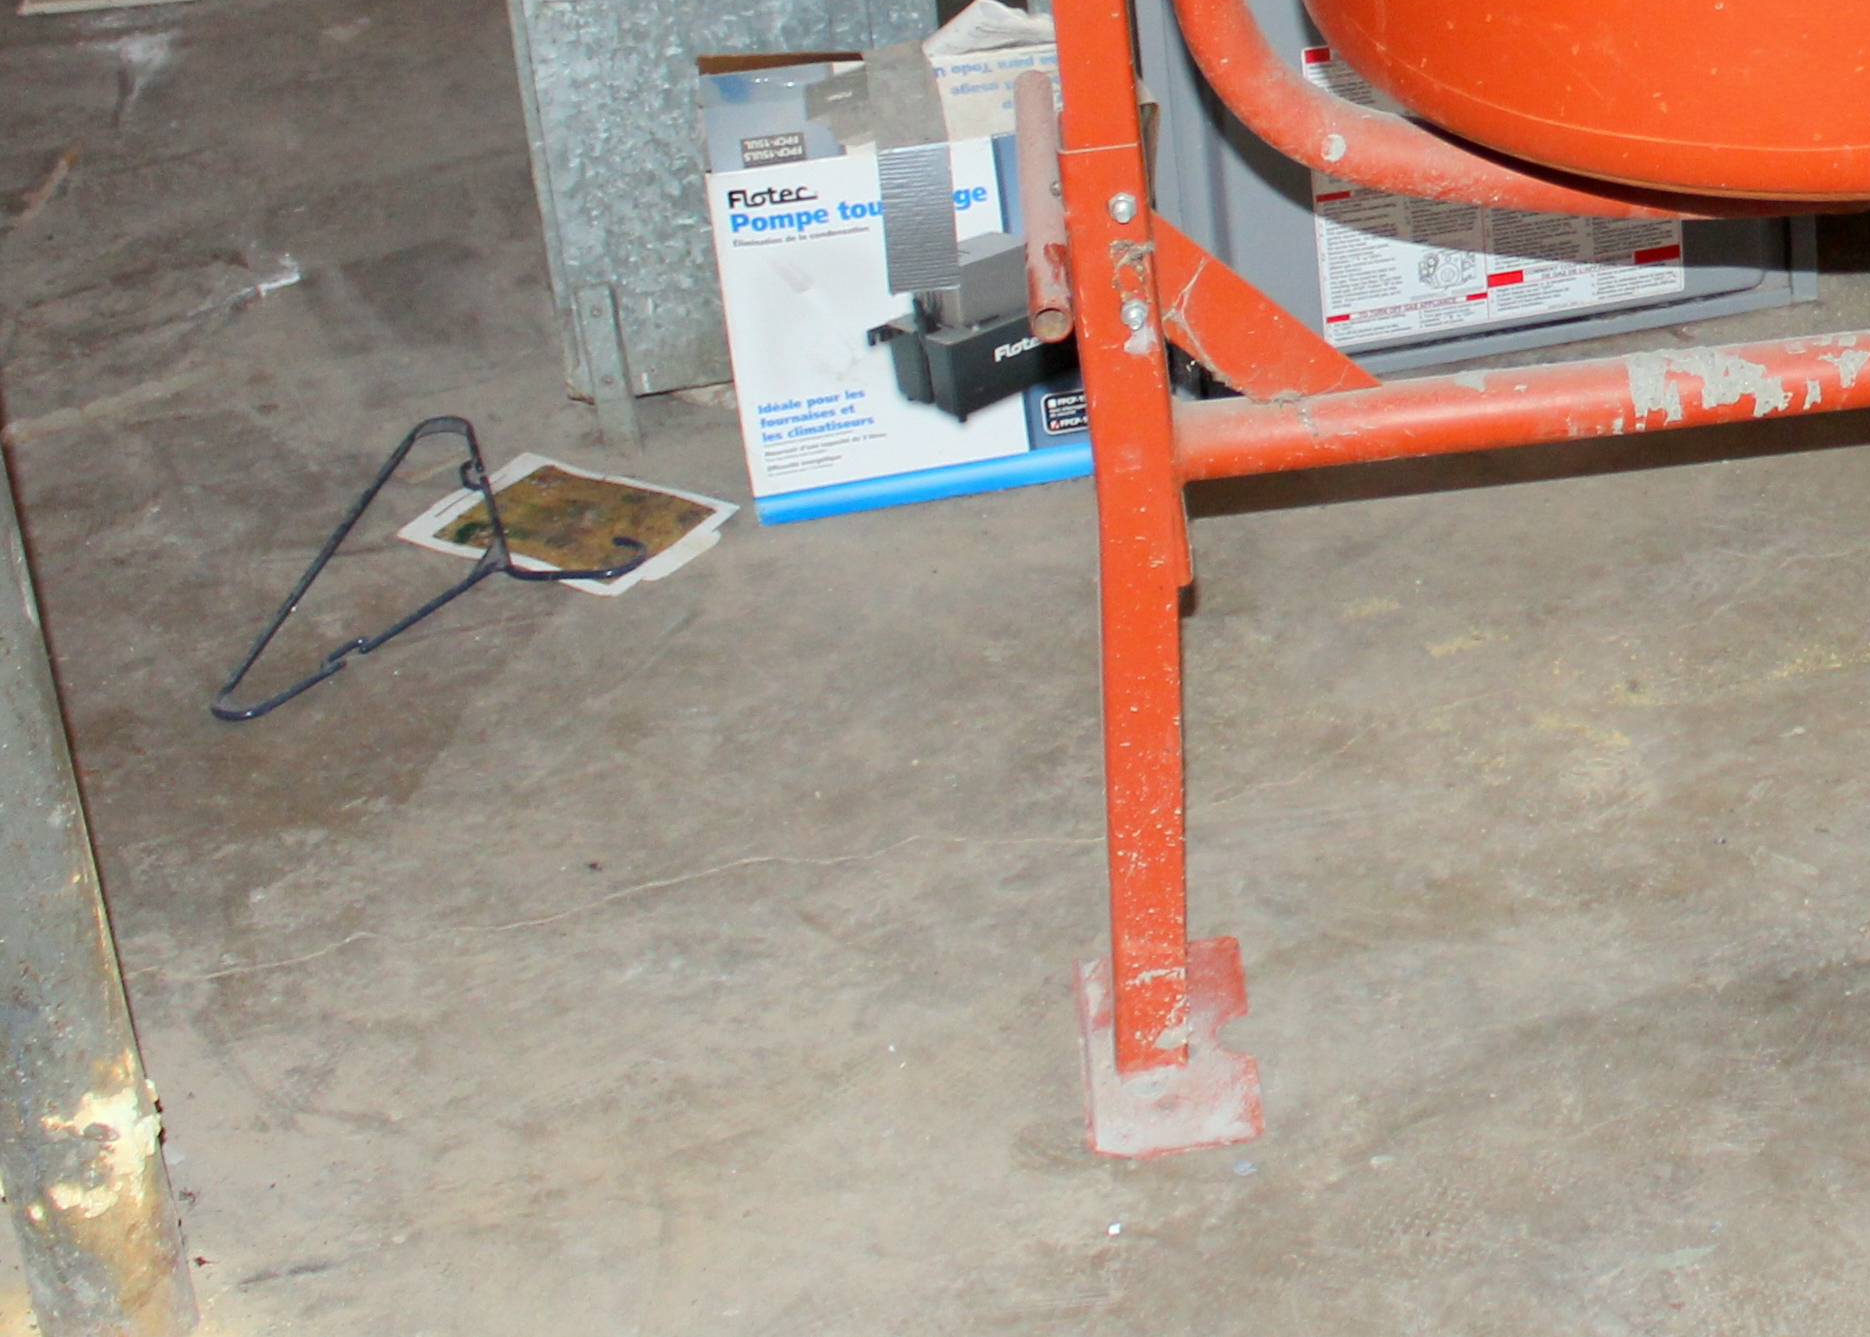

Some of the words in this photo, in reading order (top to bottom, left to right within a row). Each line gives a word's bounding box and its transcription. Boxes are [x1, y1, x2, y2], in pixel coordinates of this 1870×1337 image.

[951, 63, 993, 76] Todo
[727, 186, 818, 209] Flotec
[729, 207, 830, 233] Pompe
[993, 336, 1045, 363] Flote
[757, 399, 802, 415] Idéale
[806, 393, 840, 409] pour
[844, 389, 866, 400] les
[760, 408, 836, 429] fournaises
[840, 404, 855, 415] et
[762, 431, 783, 443] les
[787, 416, 875, 439] climatiseurs
